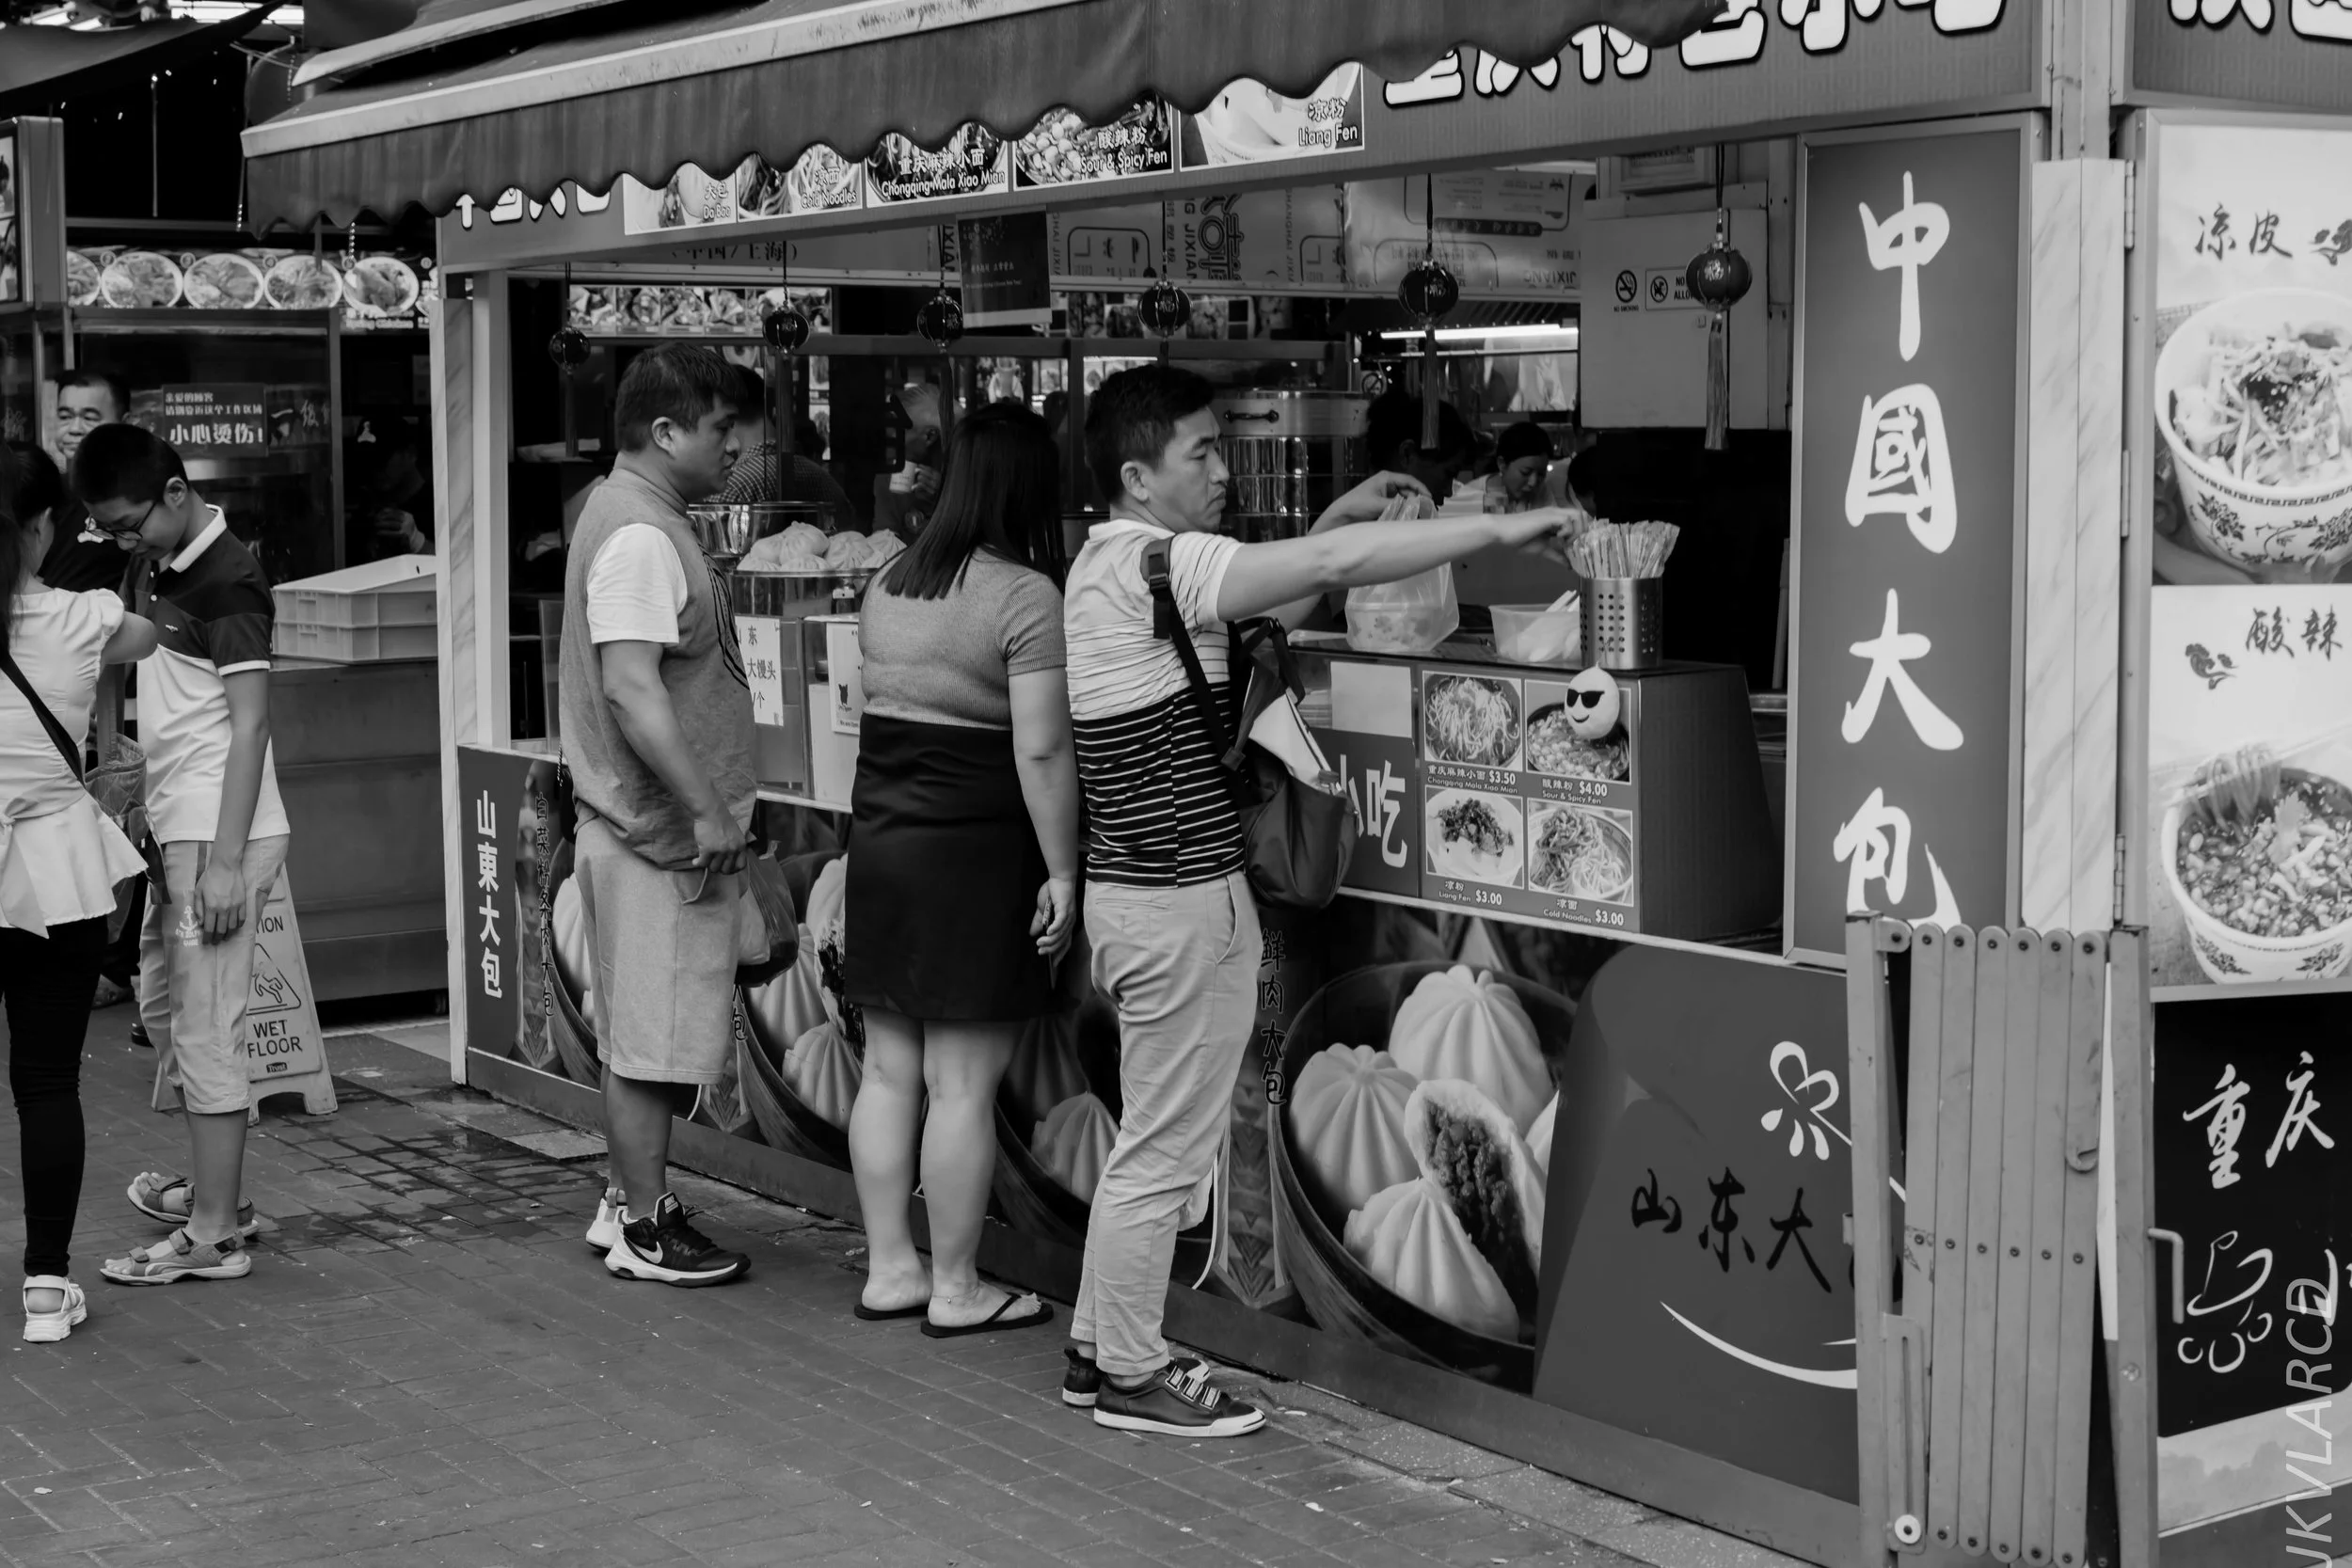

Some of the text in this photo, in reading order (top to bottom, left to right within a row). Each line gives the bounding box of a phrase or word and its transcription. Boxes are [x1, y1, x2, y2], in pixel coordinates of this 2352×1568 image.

[1298, 122, 1359, 148] Liang Fen
[898, 148, 985, 176] 重庆麻辣小面
[1080, 147, 1168, 173] Sour & Spicy Fen
[705, 181, 730, 200] 大包
[882, 169, 1005, 198] Chongqing Mala Xiao Mian
[801, 188, 857, 209] Cold Noodles
[703, 203, 731, 219] Da Bao
[2195, 200, 2293, 261] 凉皮
[1674, 289, 1693, 300] ALLO
[1833, 170, 1964, 929] 中國大包
[2245, 605, 2343, 661] 酸辣
[1427, 764, 1517, 785] 重庆麻辣小面 $3.50
[1427, 776, 1464, 788] Chongqing
[1466, 781, 1483, 790] Mala
[1501, 785, 1518, 794] Mian
[1542, 790, 1558, 799] Sour
[1568, 793, 1586, 804] Spicy
[1588, 795, 1601, 804] Fen
[1579, 780, 1608, 798] $4.00
[476, 789, 503, 999] 山東大包
[1438, 892, 1457, 901] Liang
[1475, 889, 1503, 906] $3.00
[1543, 908, 1624, 927] Cold Noodles $3.00
[1261, 927, 1288, 1106] 鲜肉大包
[253, 1019, 288, 1039] WET
[246, 1036, 303, 1059] FLOOR
[2182, 1051, 2335, 1189] 重庆
